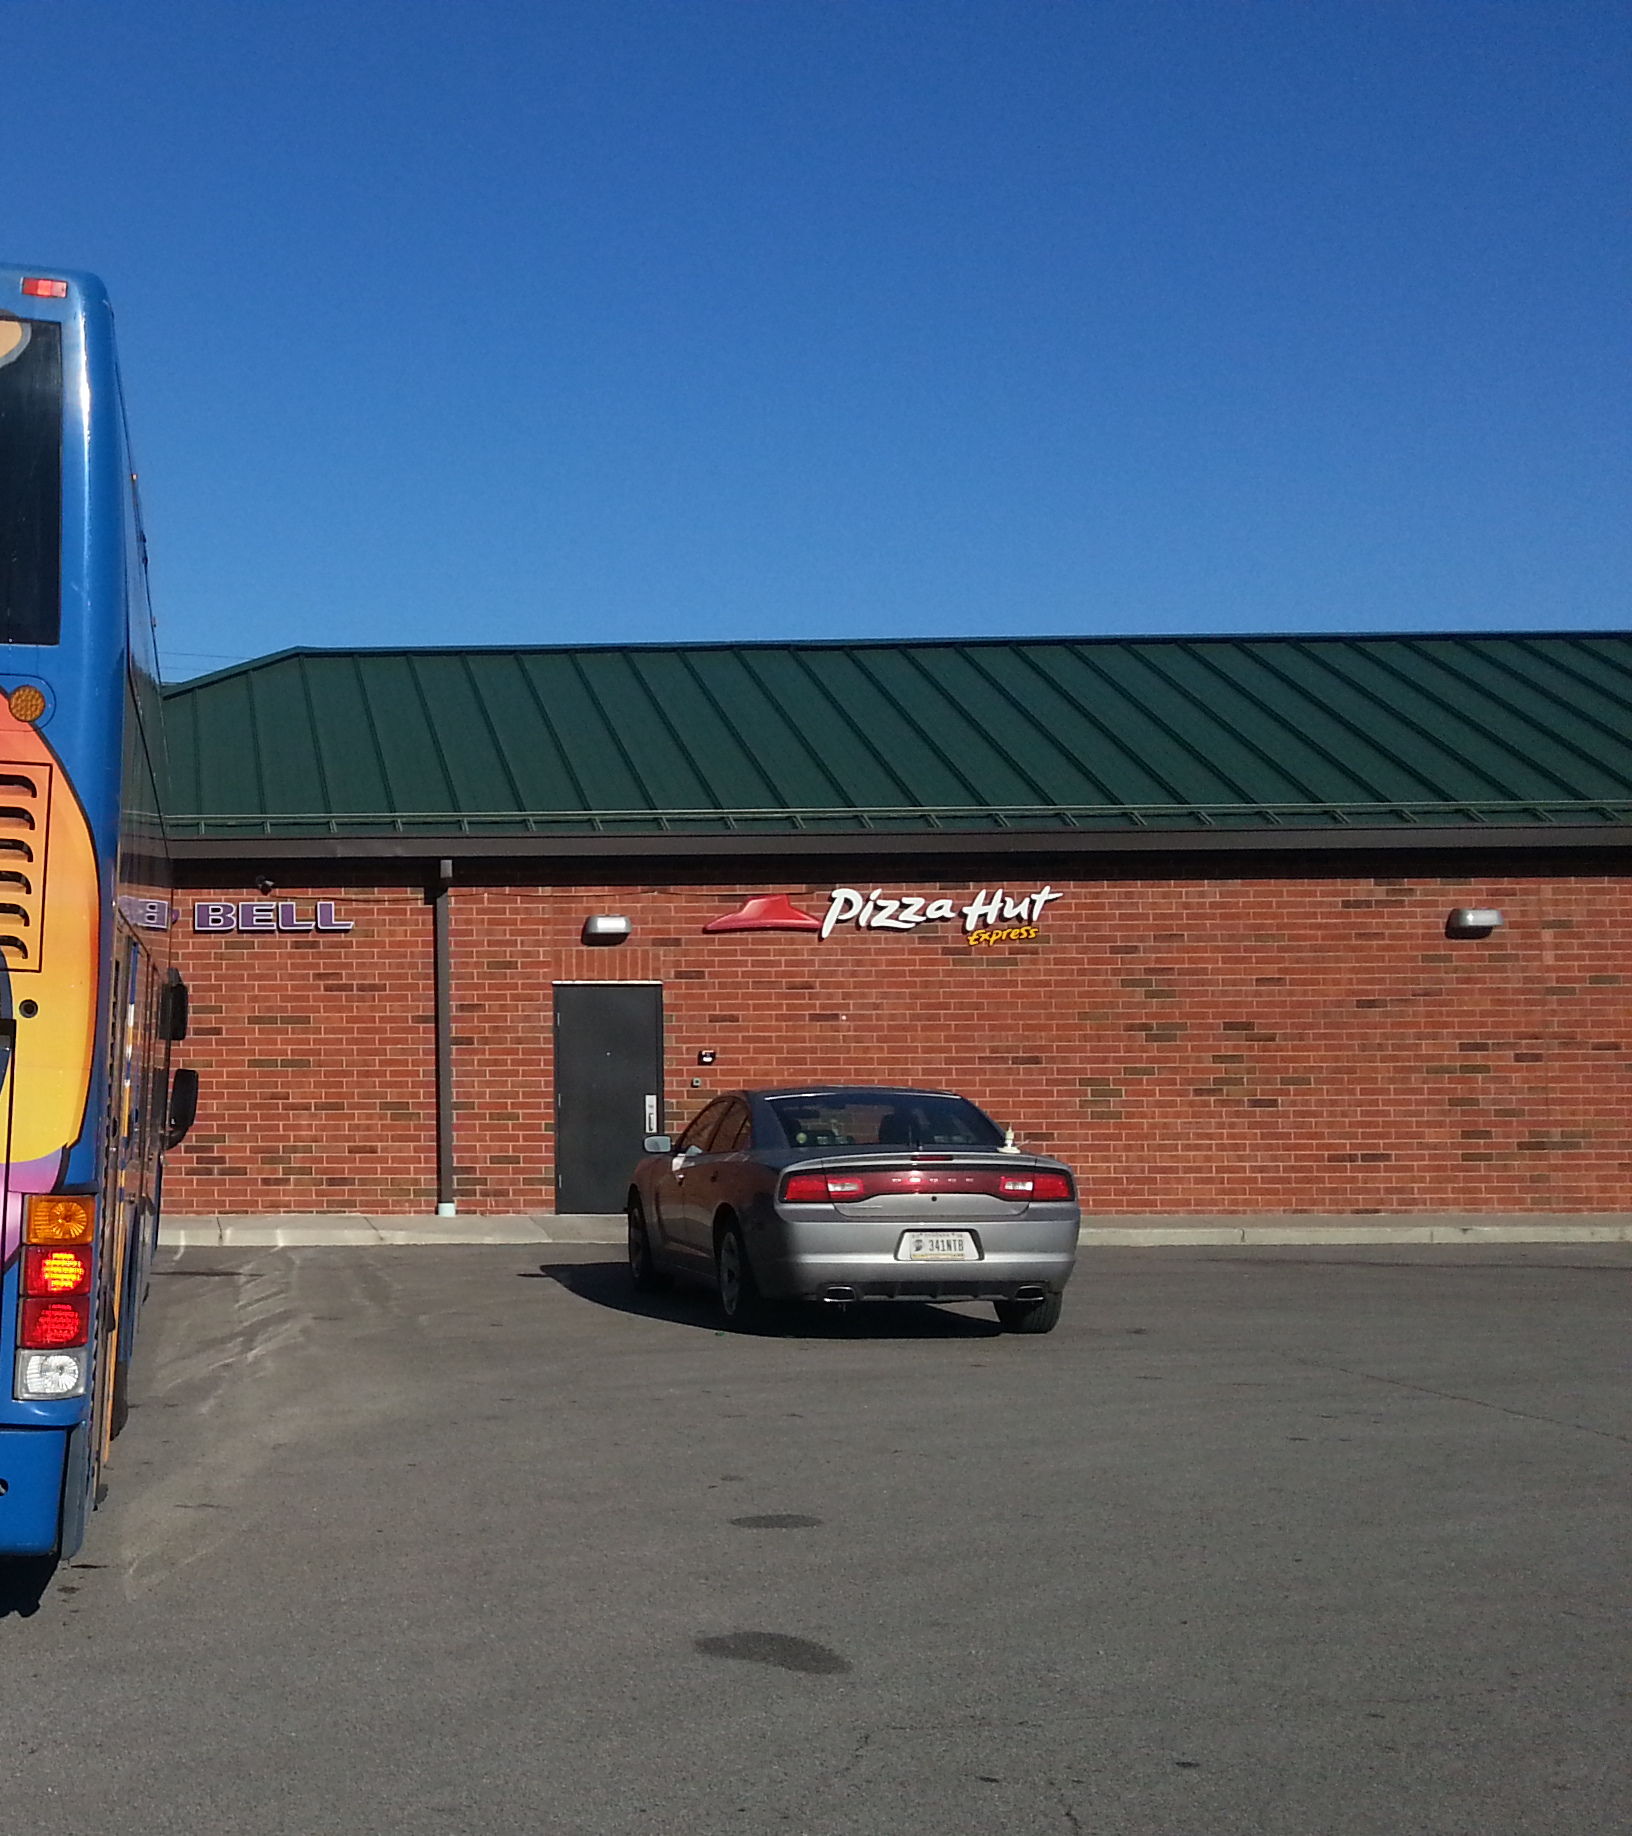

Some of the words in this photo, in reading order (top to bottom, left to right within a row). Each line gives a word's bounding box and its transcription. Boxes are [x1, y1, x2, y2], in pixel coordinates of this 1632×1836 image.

[195, 901, 354, 930] BELL
[821, 888, 955, 939] Pizza
[959, 885, 1063, 930] Hut
[968, 926, 1039, 946] Express
